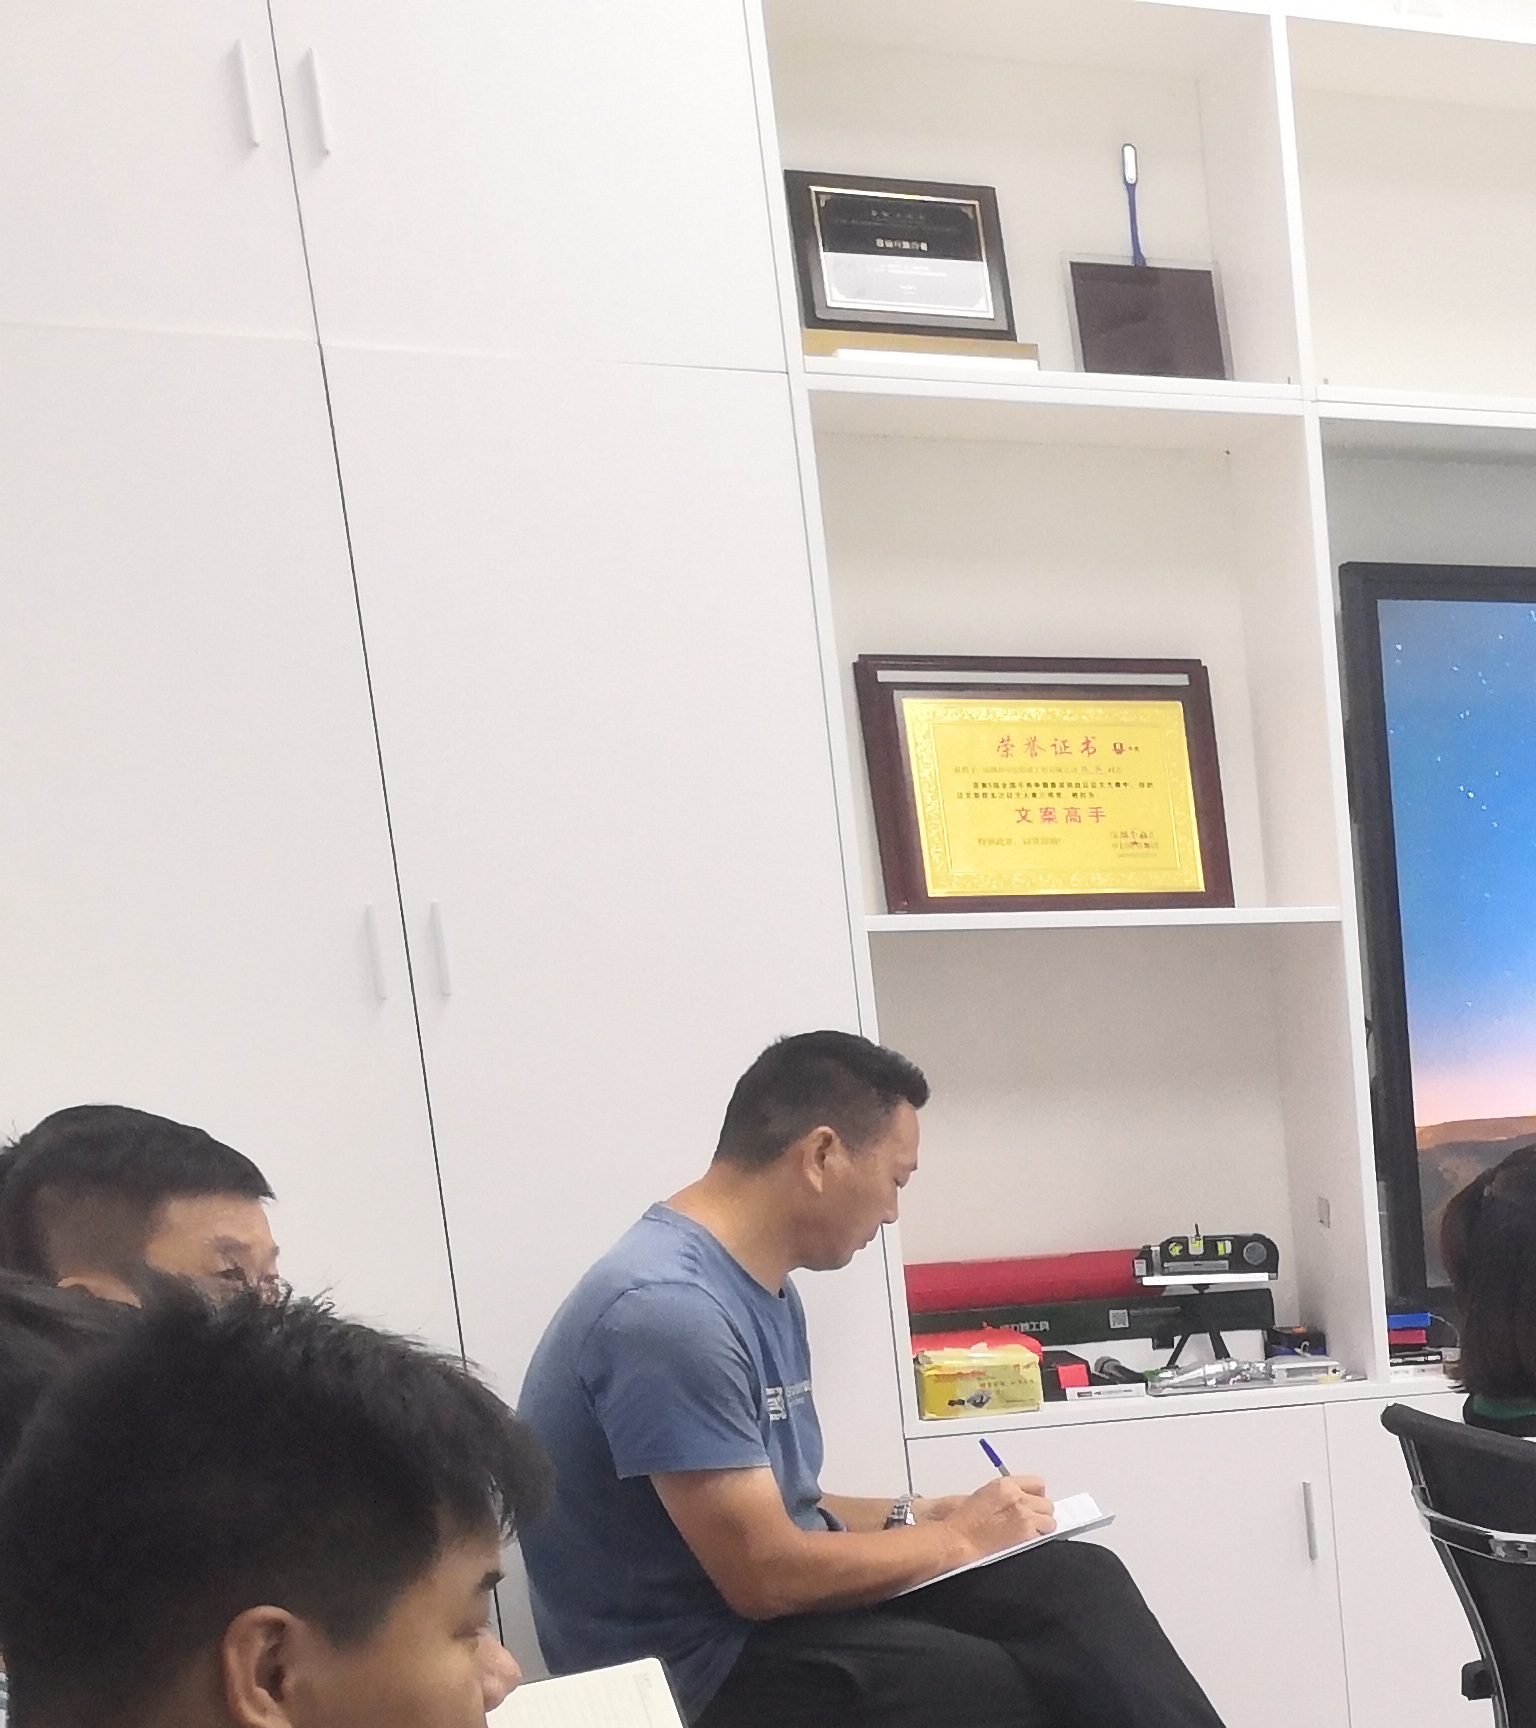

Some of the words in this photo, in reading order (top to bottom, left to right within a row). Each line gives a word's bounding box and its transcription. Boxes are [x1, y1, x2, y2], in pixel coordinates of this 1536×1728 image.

[996, 735, 1098, 758] 荣誉证书
[1015, 806, 1106, 824] 文案高手
